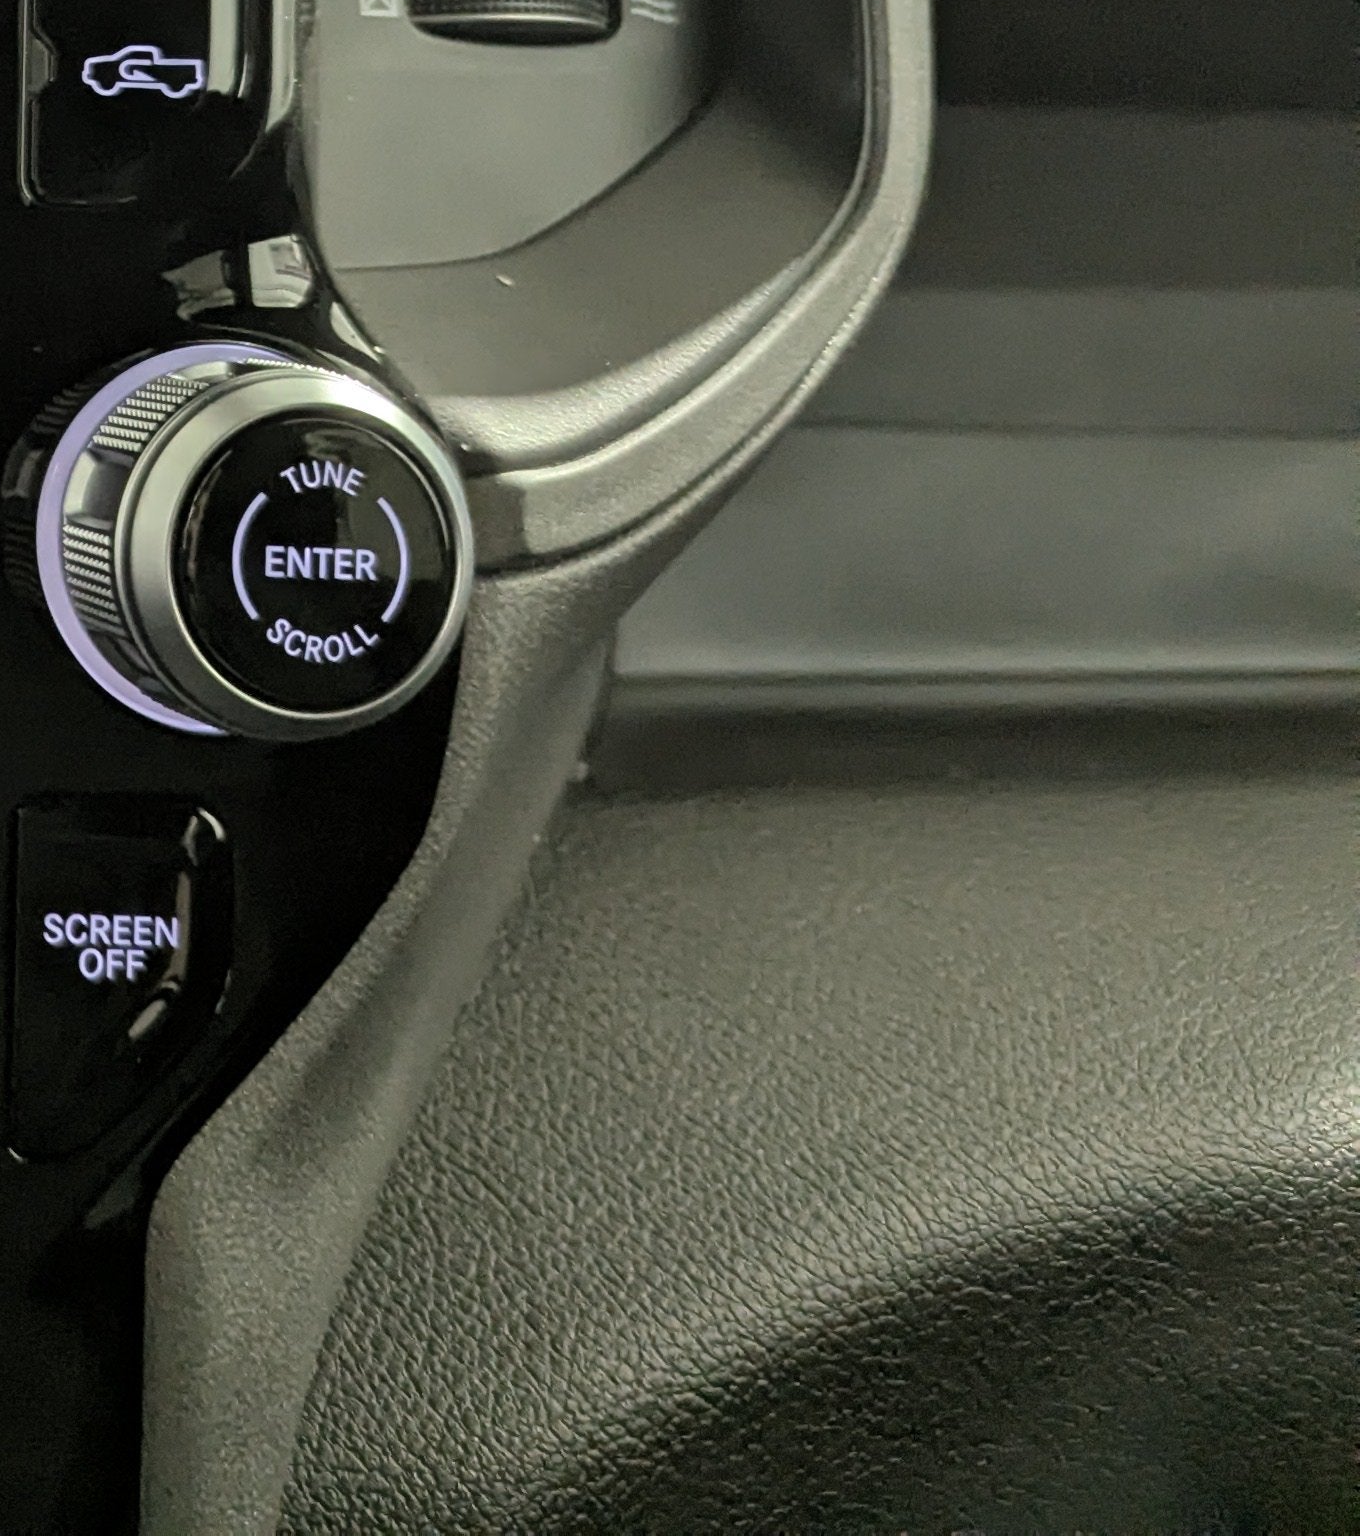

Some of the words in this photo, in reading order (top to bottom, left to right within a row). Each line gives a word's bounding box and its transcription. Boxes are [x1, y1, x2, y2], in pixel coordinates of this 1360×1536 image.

[280, 460, 365, 496] TUNE
[264, 545, 377, 581] ENTER
[266, 618, 379, 663] SCROLL
[43, 913, 180, 951] SCREEN
[78, 947, 145, 980] OFF
